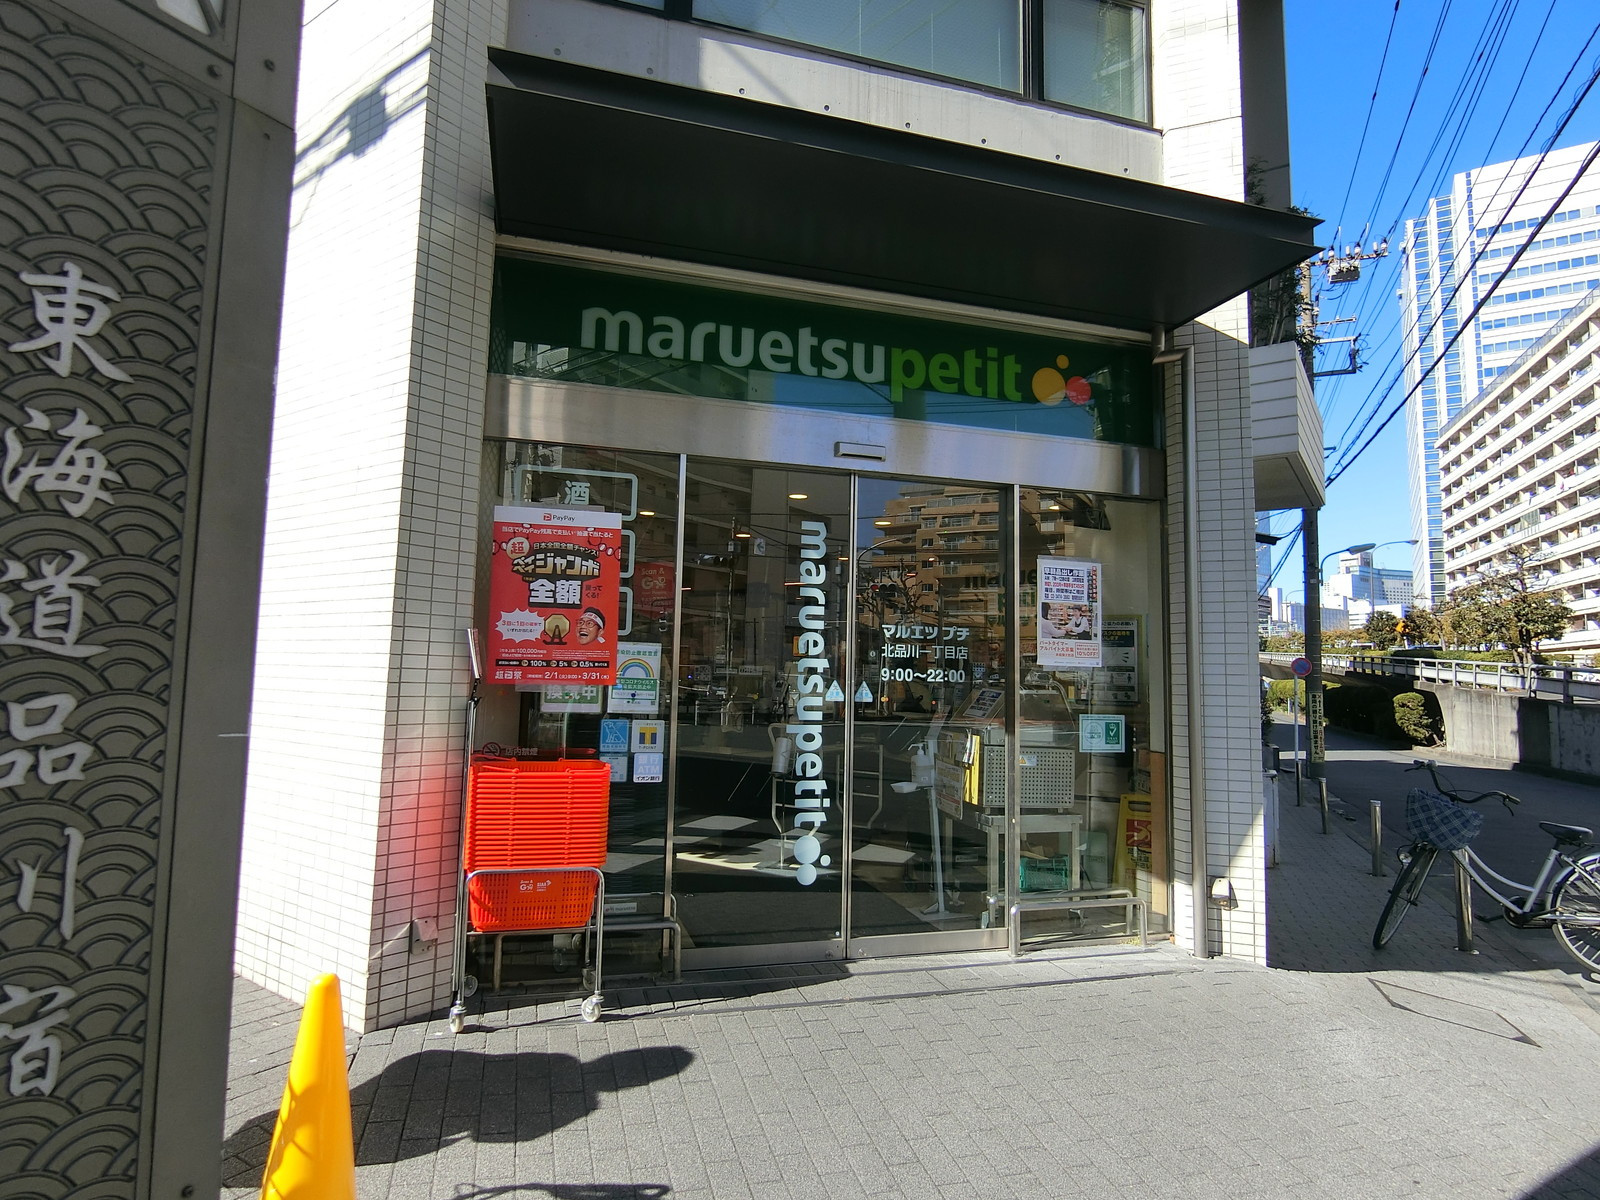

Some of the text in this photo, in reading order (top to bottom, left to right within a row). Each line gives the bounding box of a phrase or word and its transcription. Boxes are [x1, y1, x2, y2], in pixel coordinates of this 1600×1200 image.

[564, 480, 590, 505] 酒
[552, 514, 576, 523] PayPay
[511, 541, 525, 555] 超
[529, 578, 583, 605] 全額
[881, 624, 970, 641] マルエツ プチ
[881, 643, 969, 660] 北品川一丁目店
[546, 684, 597, 700] 換気中
[638, 765, 660, 774] ATM
